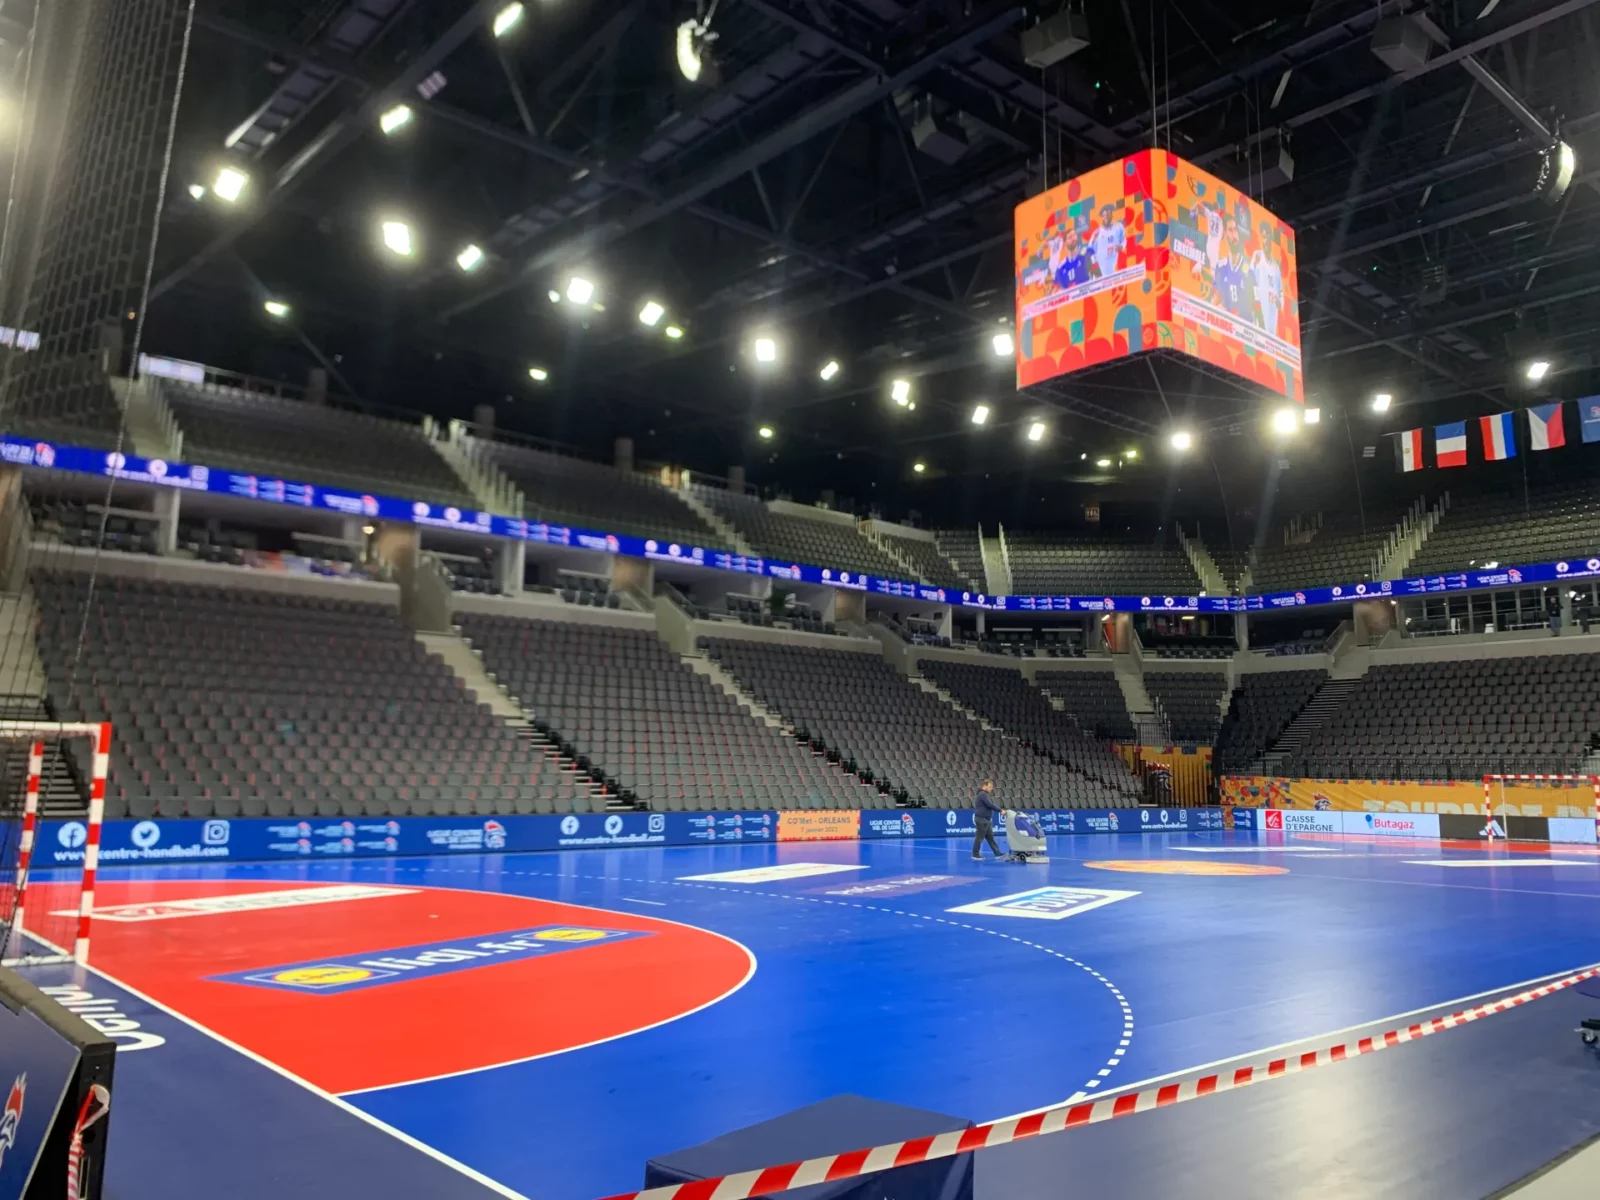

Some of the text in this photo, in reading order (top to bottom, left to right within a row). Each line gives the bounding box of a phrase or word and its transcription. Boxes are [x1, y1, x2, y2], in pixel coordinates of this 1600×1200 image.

[1285, 815, 1315, 823] CAISSE
[1286, 823, 1334, 832] D'EPARGNE
[1374, 818, 1415, 830] Butagaz
